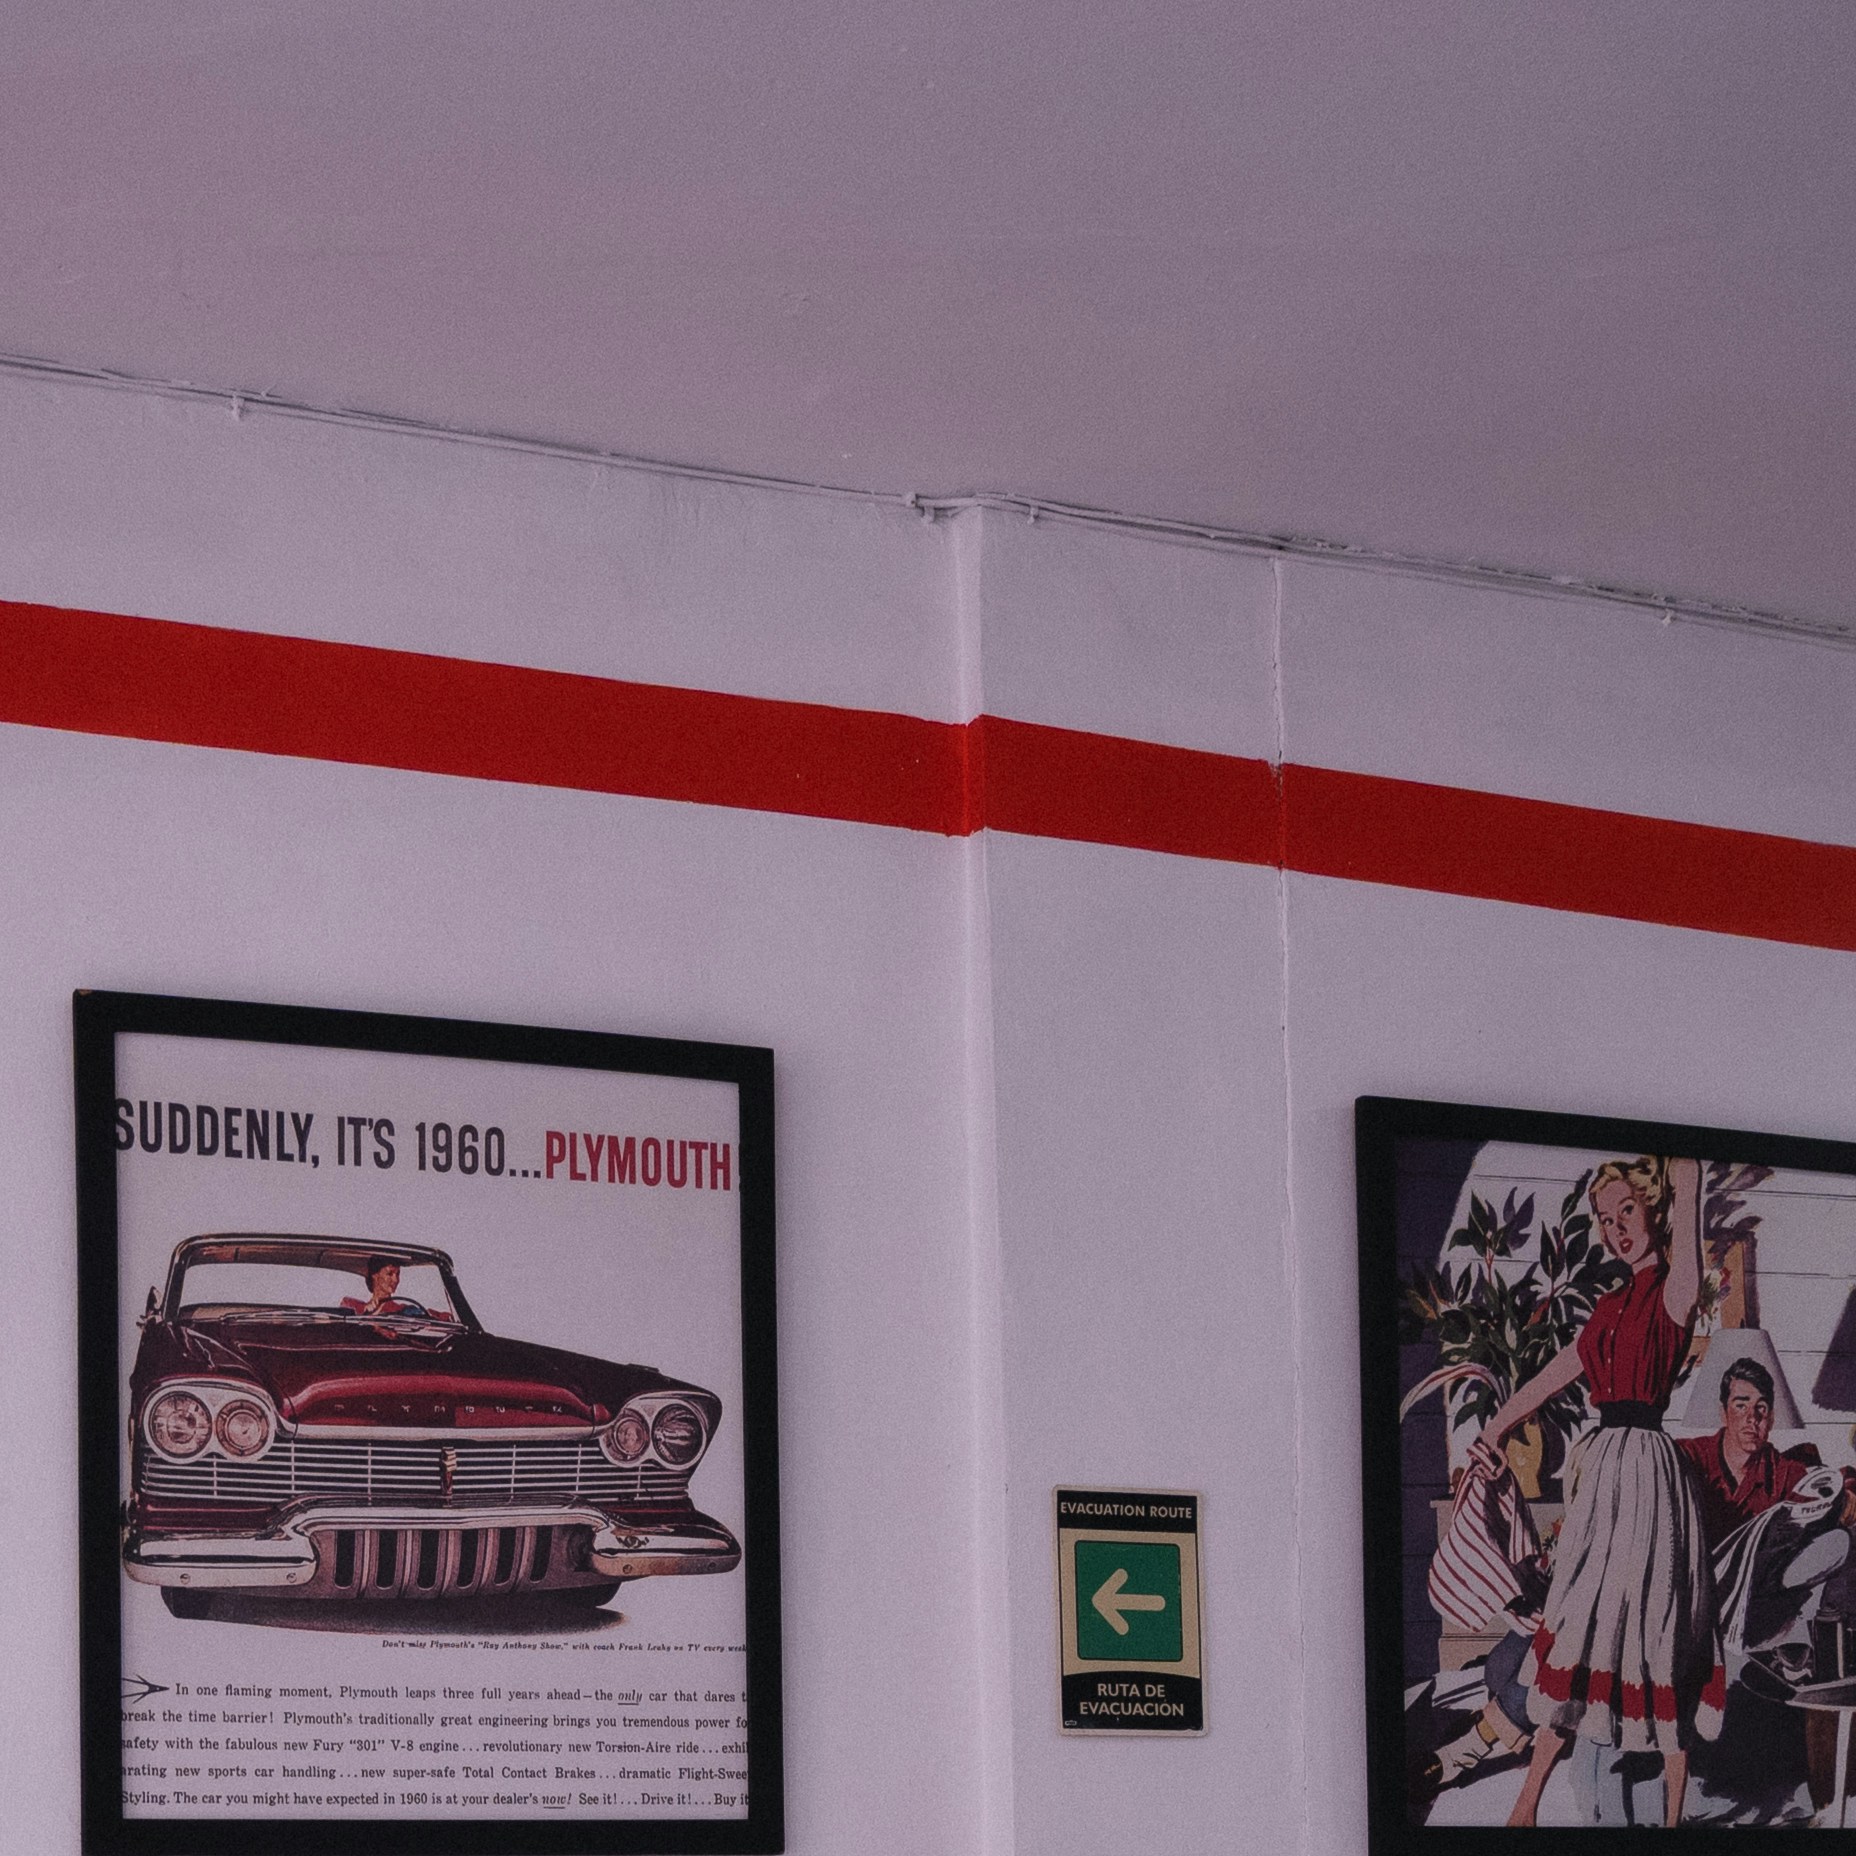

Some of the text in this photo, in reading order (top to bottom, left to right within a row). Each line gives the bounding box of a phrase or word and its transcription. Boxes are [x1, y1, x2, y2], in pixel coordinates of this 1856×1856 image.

[116, 1098, 320, 1169] SUDDENLY,
[337, 1116, 396, 1170] IT'S
[1059, 1501, 1193, 1519] EVACUATION ROUTE
[175, 1682, 190, 1697] In
[195, 1685, 219, 1697] one
[224, 1683, 273, 1700] flaming
[278, 1685, 333, 1699] moment,
[339, 1685, 399, 1701] Plymouth
[404, 1685, 437, 1702] leaps
[442, 1686, 475, 1700] three
[480, 1686, 502, 1700] full
[507, 1690, 541, 1702] years
[617, 1688, 644, 1704] only
[648, 1692, 668, 1703] car
[673, 1689, 699, 1703] that
[703, 1689, 736, 1703] dares
[1096, 1682, 1166, 1698] RUTA DE
[1078, 1698, 1185, 1717] EVACUACIÓN
[161, 1708, 183, 1723] the
[187, 1709, 217, 1724] time
[221, 1710, 274, 1724] barrier!
[282, 1710, 354, 1727] Plymouth's
[357, 1712, 436, 1728] traditionally
[439, 1713, 474, 1728] great
[477, 1713, 550, 1729] engineering
[552, 1713, 592, 1730] brings
[595, 1717, 618, 1730] you
[621, 1714, 691, 1729] tremendous
[694, 1718, 731, 1731] power
[164, 1736, 194, 1750] with
[198, 1736, 220, 1751] the
[224, 1736, 279, 1751] fabulous
[282, 1741, 309, 1752] new
[312, 1738, 345, 1754] Fury
[389, 1738, 415, 1753] V-8
[567, 1742, 592, 1754] new
[595, 1740, 672, 1754] Torsion-Aire
[174, 1766, 202, 1778] new
[207, 1765, 248, 1780] sports
[253, 1767, 276, 1778] car
[392, 1765, 457, 1781] super-safe
[461, 1765, 495, 1779] Total
[500, 1765, 548, 1780] Contact
[677, 1765, 750, 1783] Flight-Swee
[122, 1790, 171, 1806] Styling.
[172, 1790, 199, 1805] The
[200, 1793, 223, 1805] car
[225, 1794, 249, 1807] you
[251, 1791, 290, 1807] might
[292, 1791, 323, 1806] have
[325, 1791, 380, 1808] expected
[382, 1791, 396, 1805] in
[399, 1791, 429, 1806] 1960
[431, 1791, 443, 1805] is
[445, 1793, 459, 1806] at
[461, 1795, 490, 1807] your
[492, 1791, 539, 1806] dealer's
[541, 1792, 573, 1806] now!
[578, 1791, 600, 1806] See
